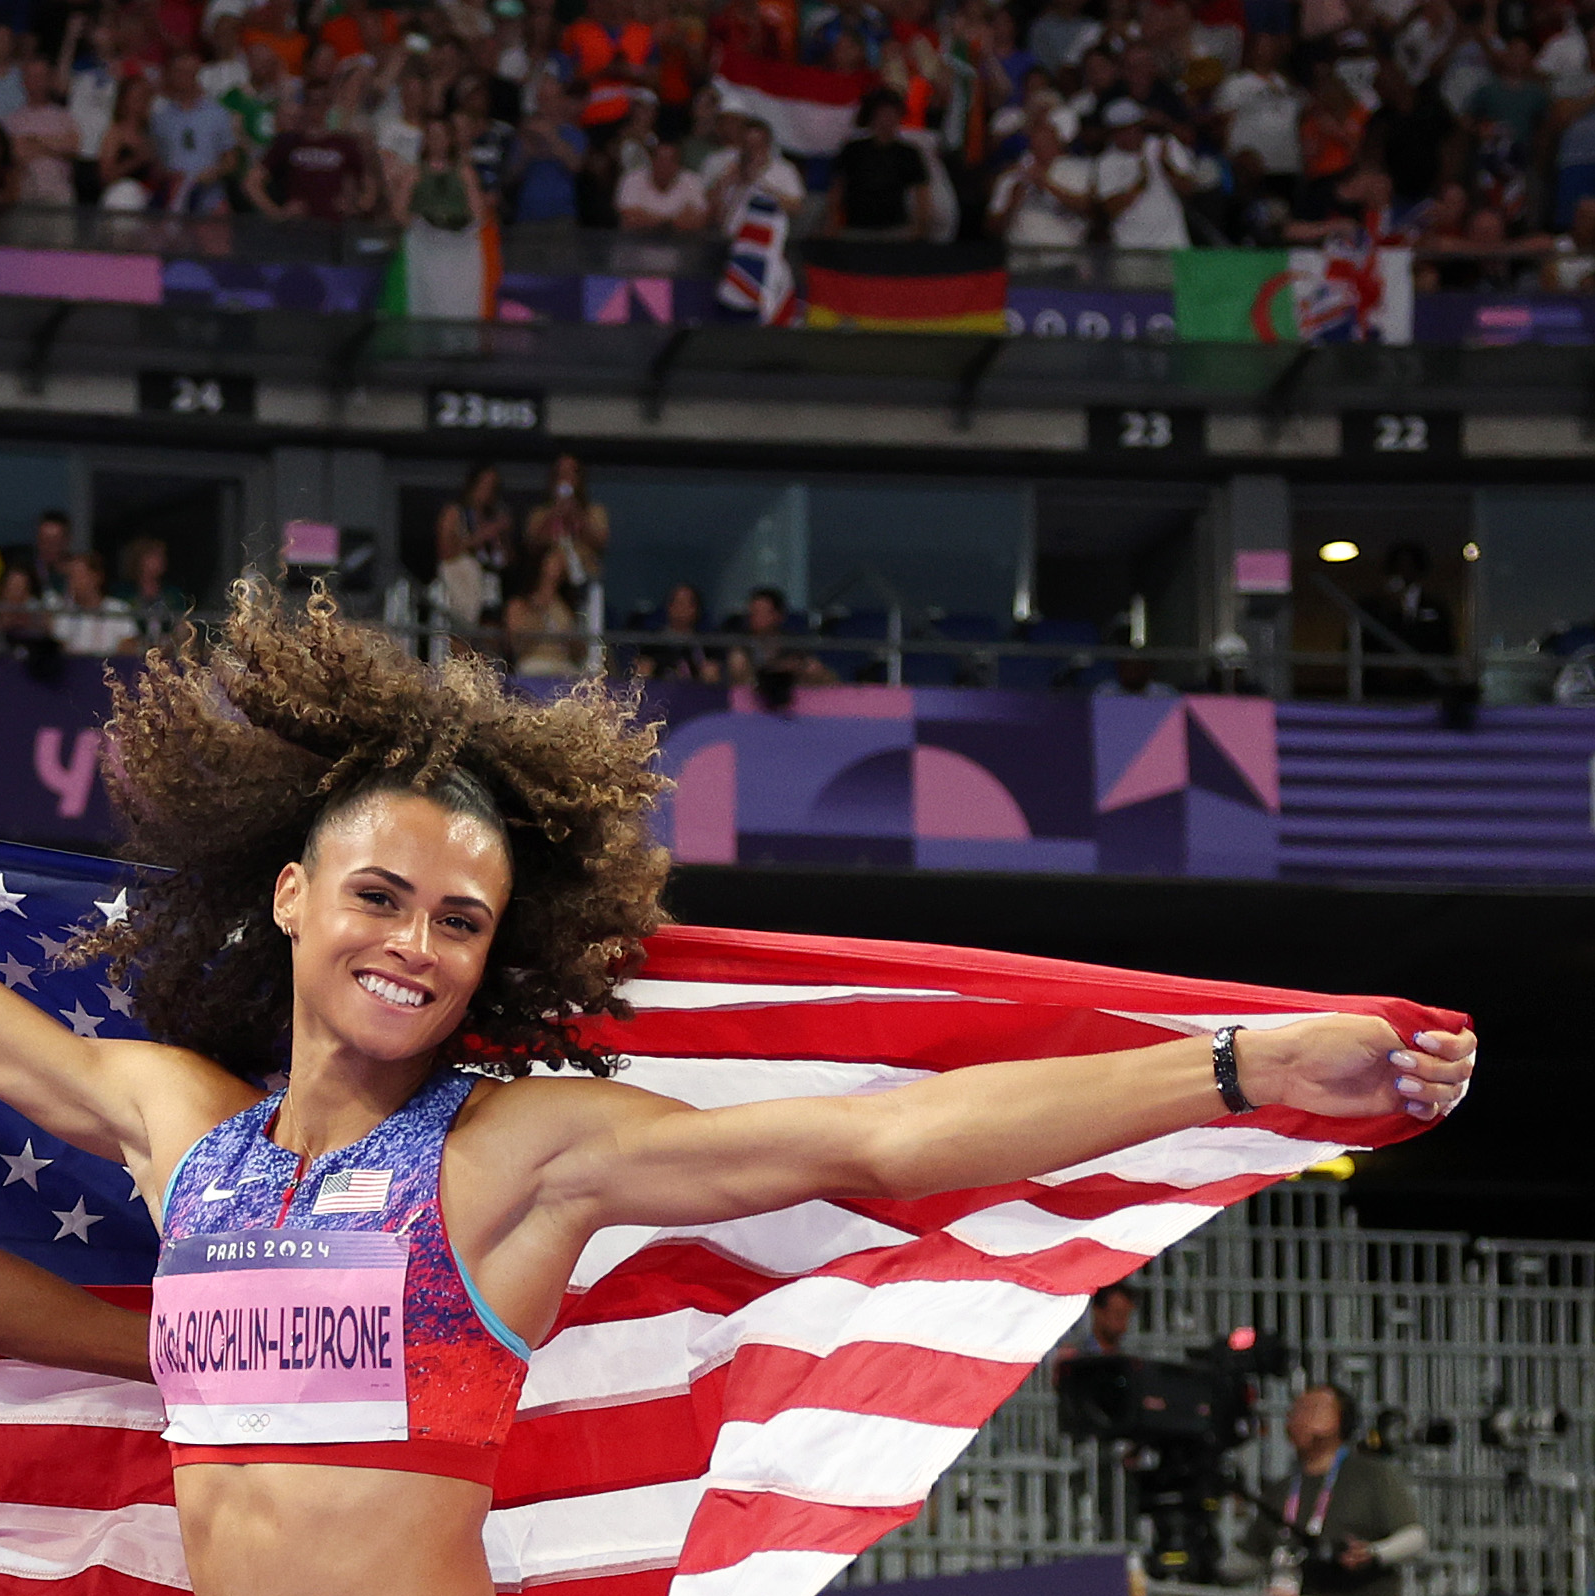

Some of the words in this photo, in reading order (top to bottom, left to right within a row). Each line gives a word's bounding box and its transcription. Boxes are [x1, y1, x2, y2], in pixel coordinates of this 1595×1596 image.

[170, 376, 224, 413] 24
[1119, 410, 1173, 448] 23
[1373, 413, 1430, 451] 22
[263, 1240, 330, 1259] 2024
